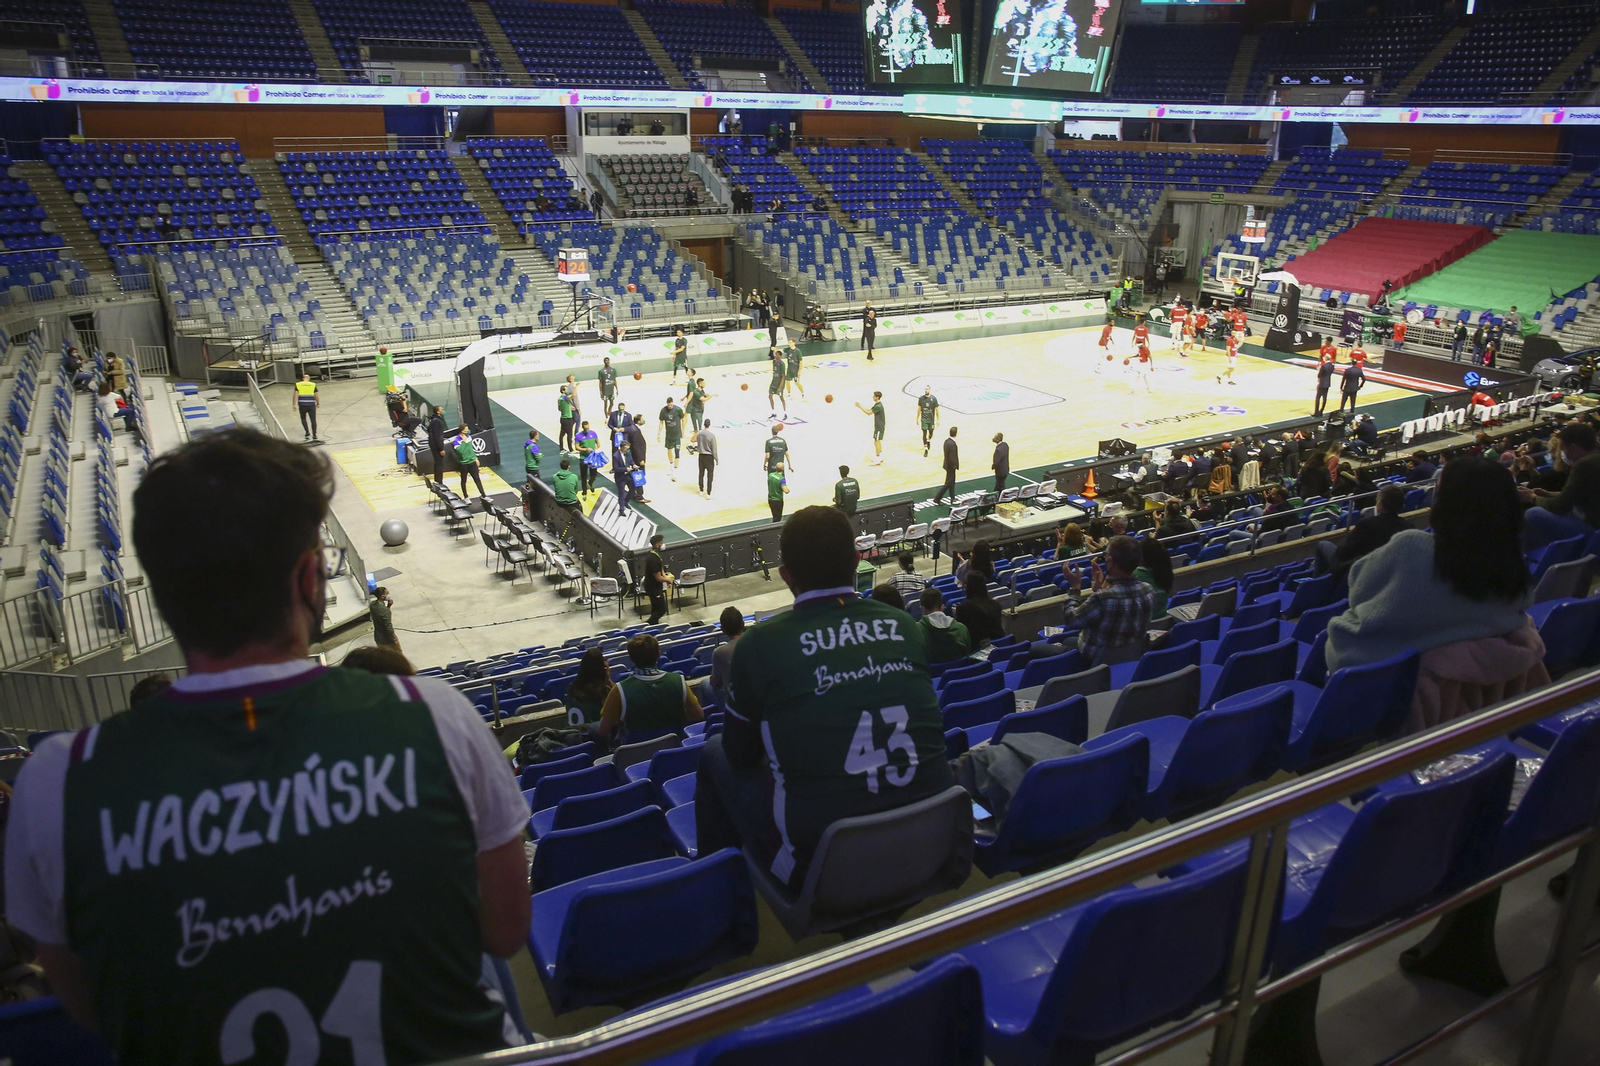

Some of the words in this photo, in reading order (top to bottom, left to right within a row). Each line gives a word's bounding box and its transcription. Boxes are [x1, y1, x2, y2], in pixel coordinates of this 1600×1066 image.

[67, 86, 110, 95] Prohibido
[569, 262, 586, 274] 24
[800, 618, 904, 656] SUÁREZ
[814, 655, 914, 695] Benahavís
[844, 704, 919, 794] 43
[100, 747, 418, 875] WACZYŃSKI
